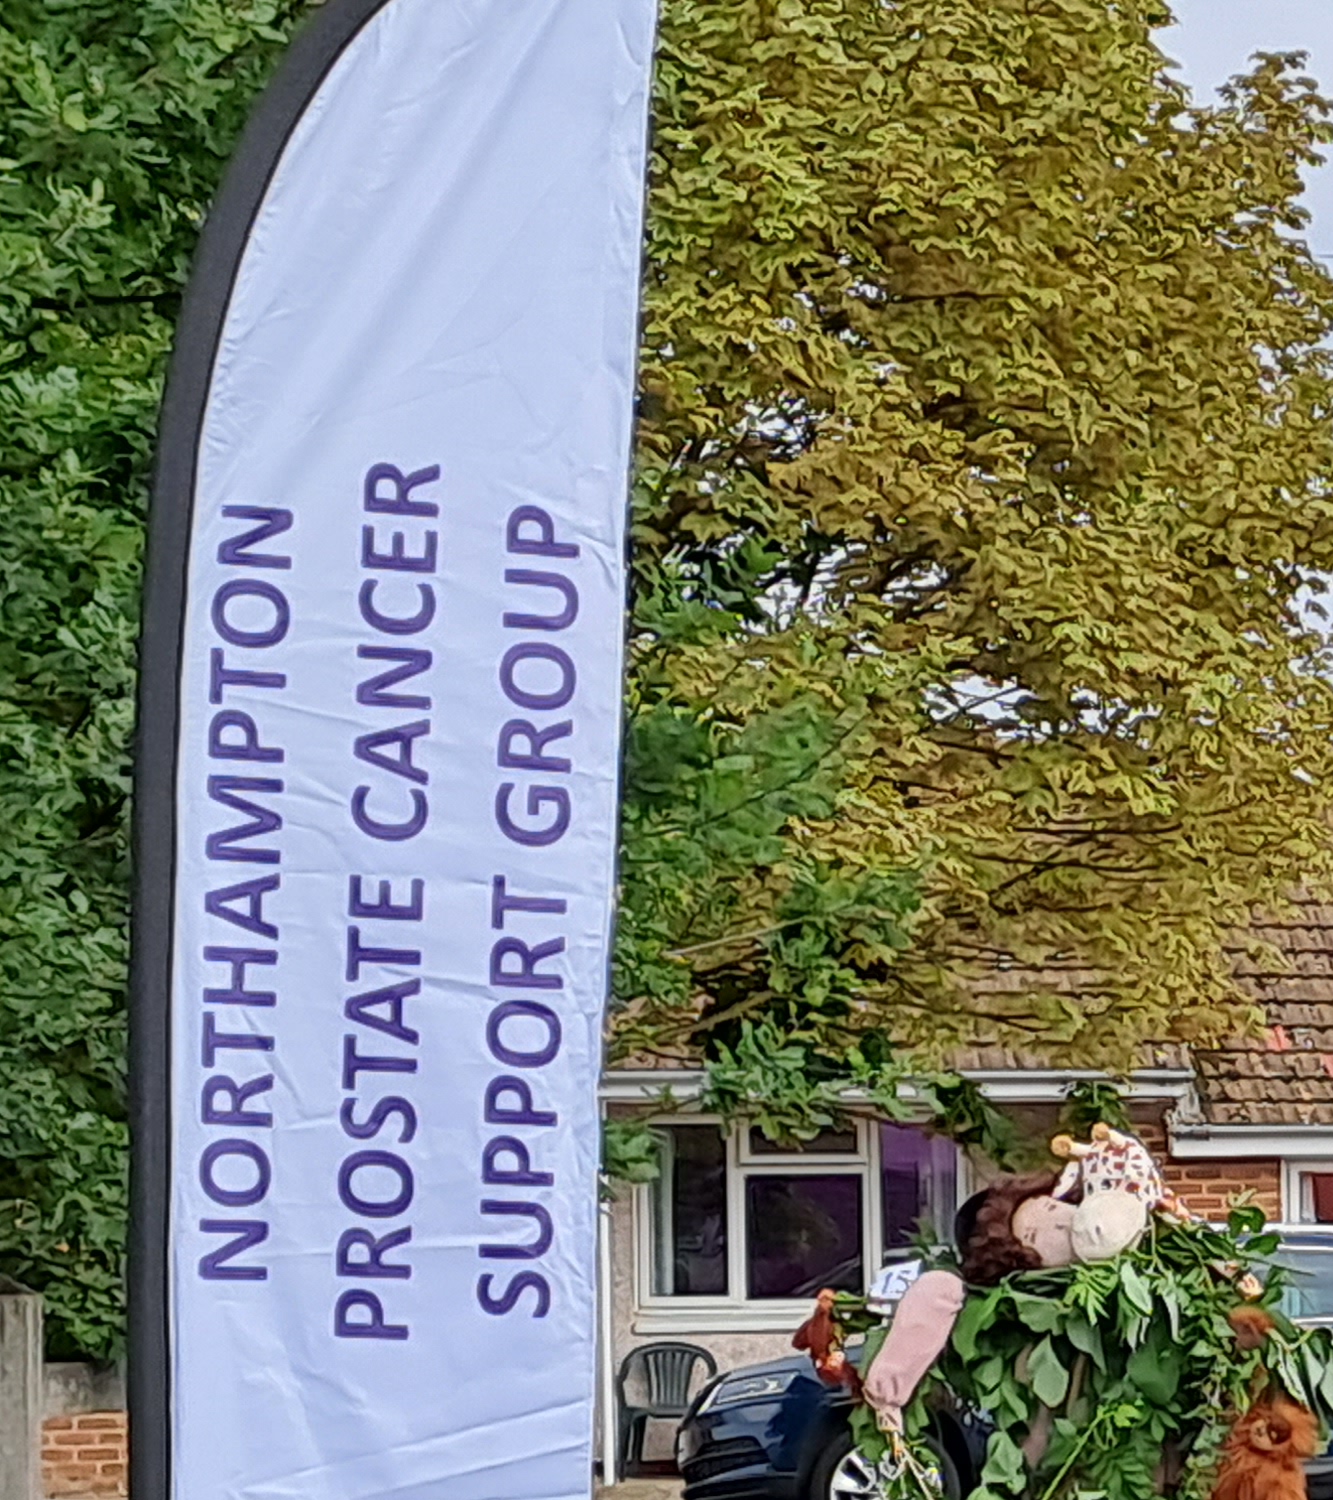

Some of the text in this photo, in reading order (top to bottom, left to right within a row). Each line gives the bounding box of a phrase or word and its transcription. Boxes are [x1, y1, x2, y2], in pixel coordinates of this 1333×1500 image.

[198, 504, 294, 1281] NORTHAMPTON
[334, 461, 442, 1340] PROSTATE CANCER
[476, 504, 580, 1318] SUPPORT GROUP
